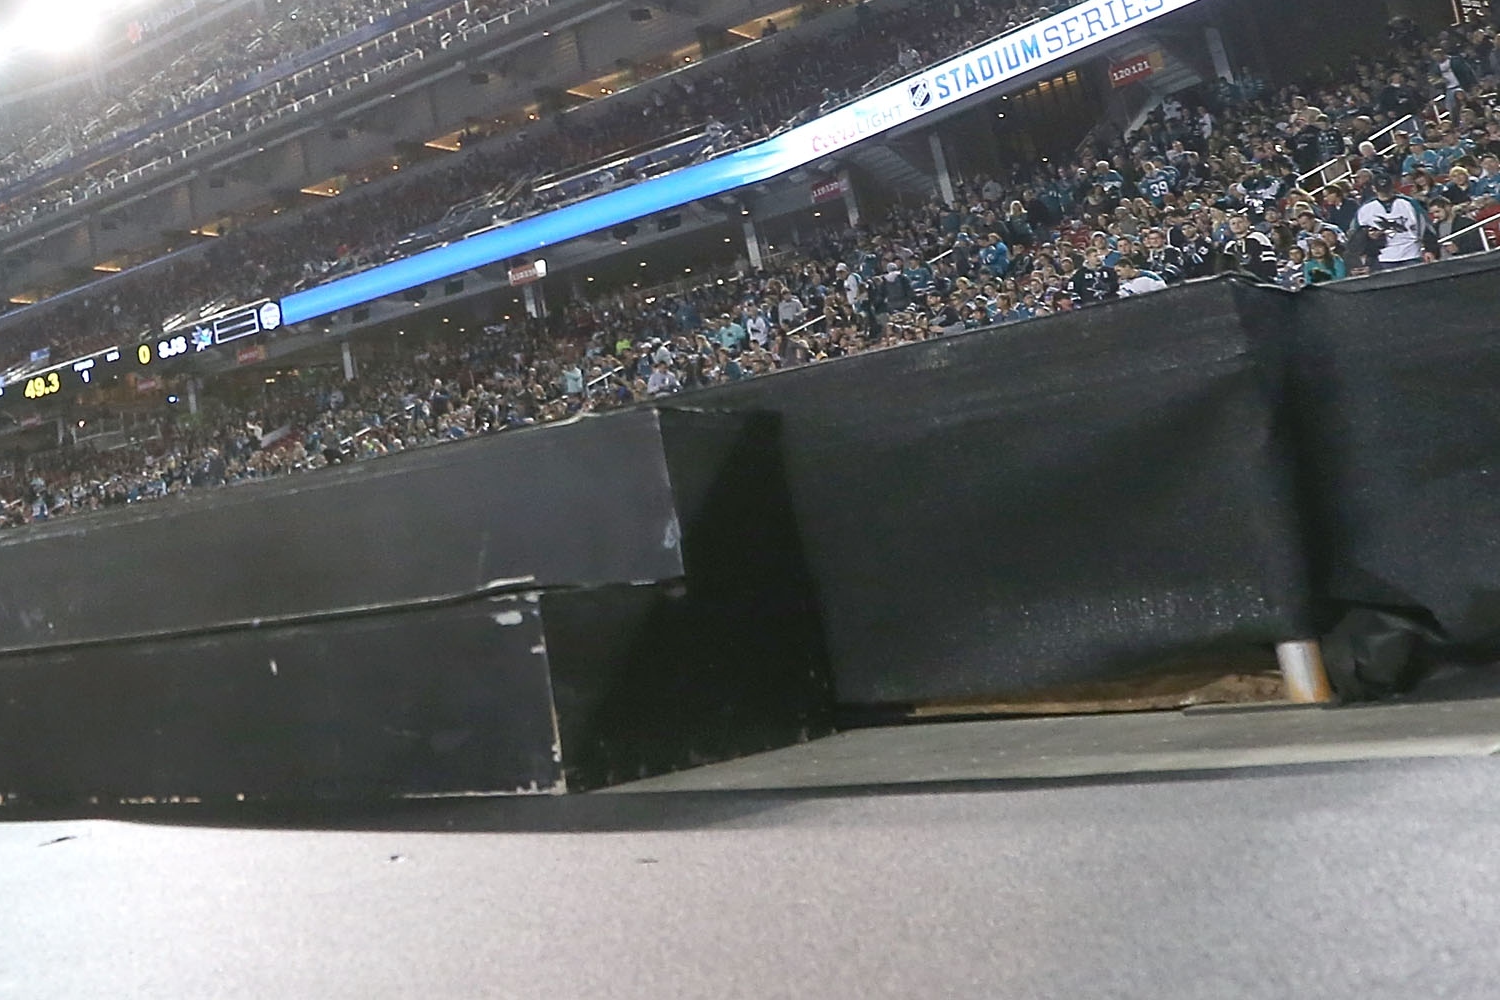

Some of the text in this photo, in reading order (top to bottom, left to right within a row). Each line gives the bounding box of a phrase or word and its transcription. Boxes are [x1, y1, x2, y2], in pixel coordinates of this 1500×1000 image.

[934, 32, 1042, 100] STADIUM
[1150, 180, 1169, 198] 39
[24, 372, 60, 399] 49.3
